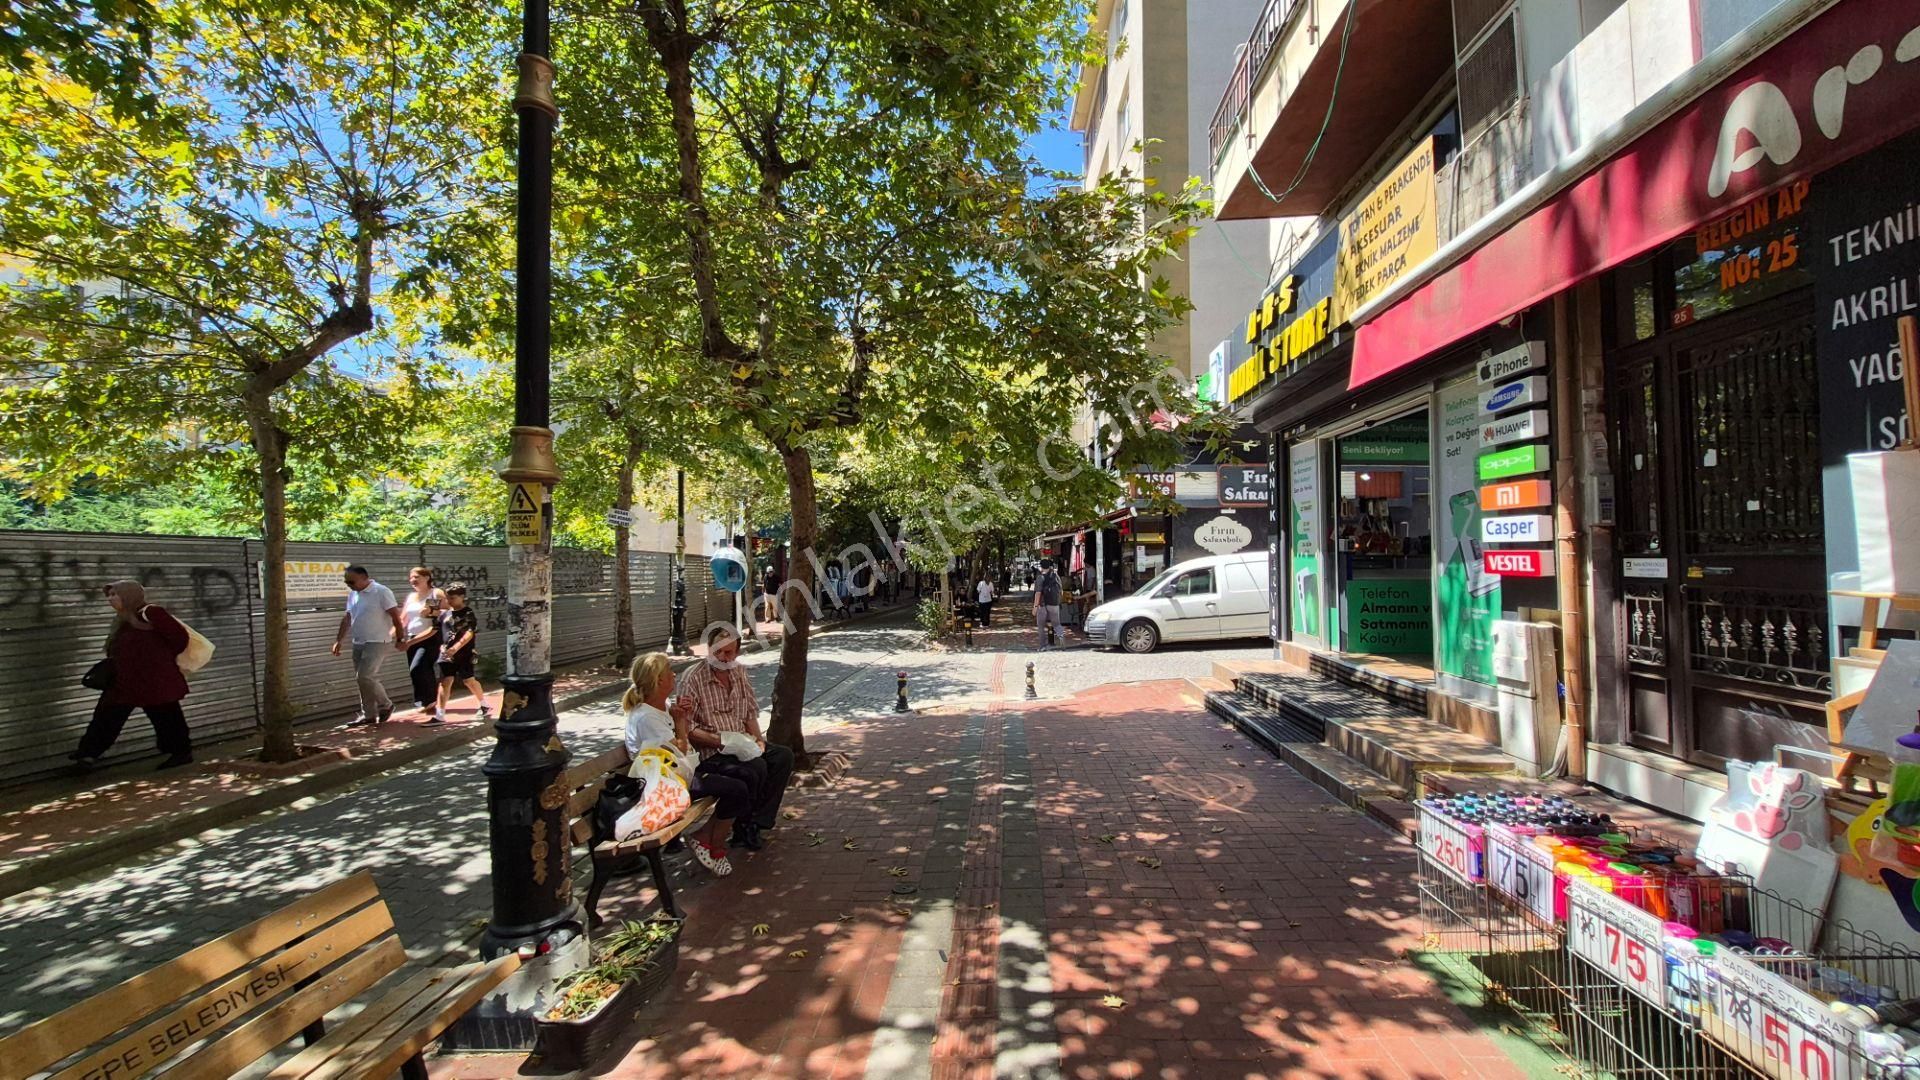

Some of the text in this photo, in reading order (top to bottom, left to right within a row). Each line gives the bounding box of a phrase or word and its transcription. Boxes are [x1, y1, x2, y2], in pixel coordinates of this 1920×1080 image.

[1708, 26, 1920, 198] Ar
[1385, 149, 1431, 205] PERAKENDE
[1777, 181, 1810, 220] AP
[1350, 205, 1402, 260] AKSESUAR
[1379, 214, 1420, 260] MALZEME
[1829, 202, 1920, 267] TEKNİ
[1351, 253, 1407, 305] YEDEK PARÇA
[1720, 234, 1798, 290] NO: 25
[1674, 311, 1687, 324] 25
[1832, 276, 1920, 331] AKRİL
[1269, 296, 1329, 375] STORE
[1494, 355, 1528, 378] iPhone
[1849, 342, 1905, 389] YAĞ
[1491, 388, 1520, 405] SAMSUNG
[1456, 426, 1479, 441] Değeri
[1496, 420, 1530, 437] HUAWEI
[1342, 446, 1362, 454] Seni
[1484, 454, 1531, 470] oppo
[1242, 470, 1268, 484] Fır
[1486, 521, 1534, 538] Casper
[285, 562, 346, 574] ATBAA
[1488, 555, 1535, 572] VESTEL
[1360, 587, 1410, 599] Telefon
[1360, 602, 1419, 614] Almanın
[1360, 619, 1429, 630] Satmanın
[1435, 835, 1466, 874] 250
[1497, 848, 1529, 900] 75
[1605, 925, 1647, 982] 75
[148, 964, 286, 1057] BELEDİYESİ
[1722, 957, 1774, 995] CADENCE
[1778, 989, 1817, 1020] STYLE
[1820, 1013, 1857, 1040] MATT
